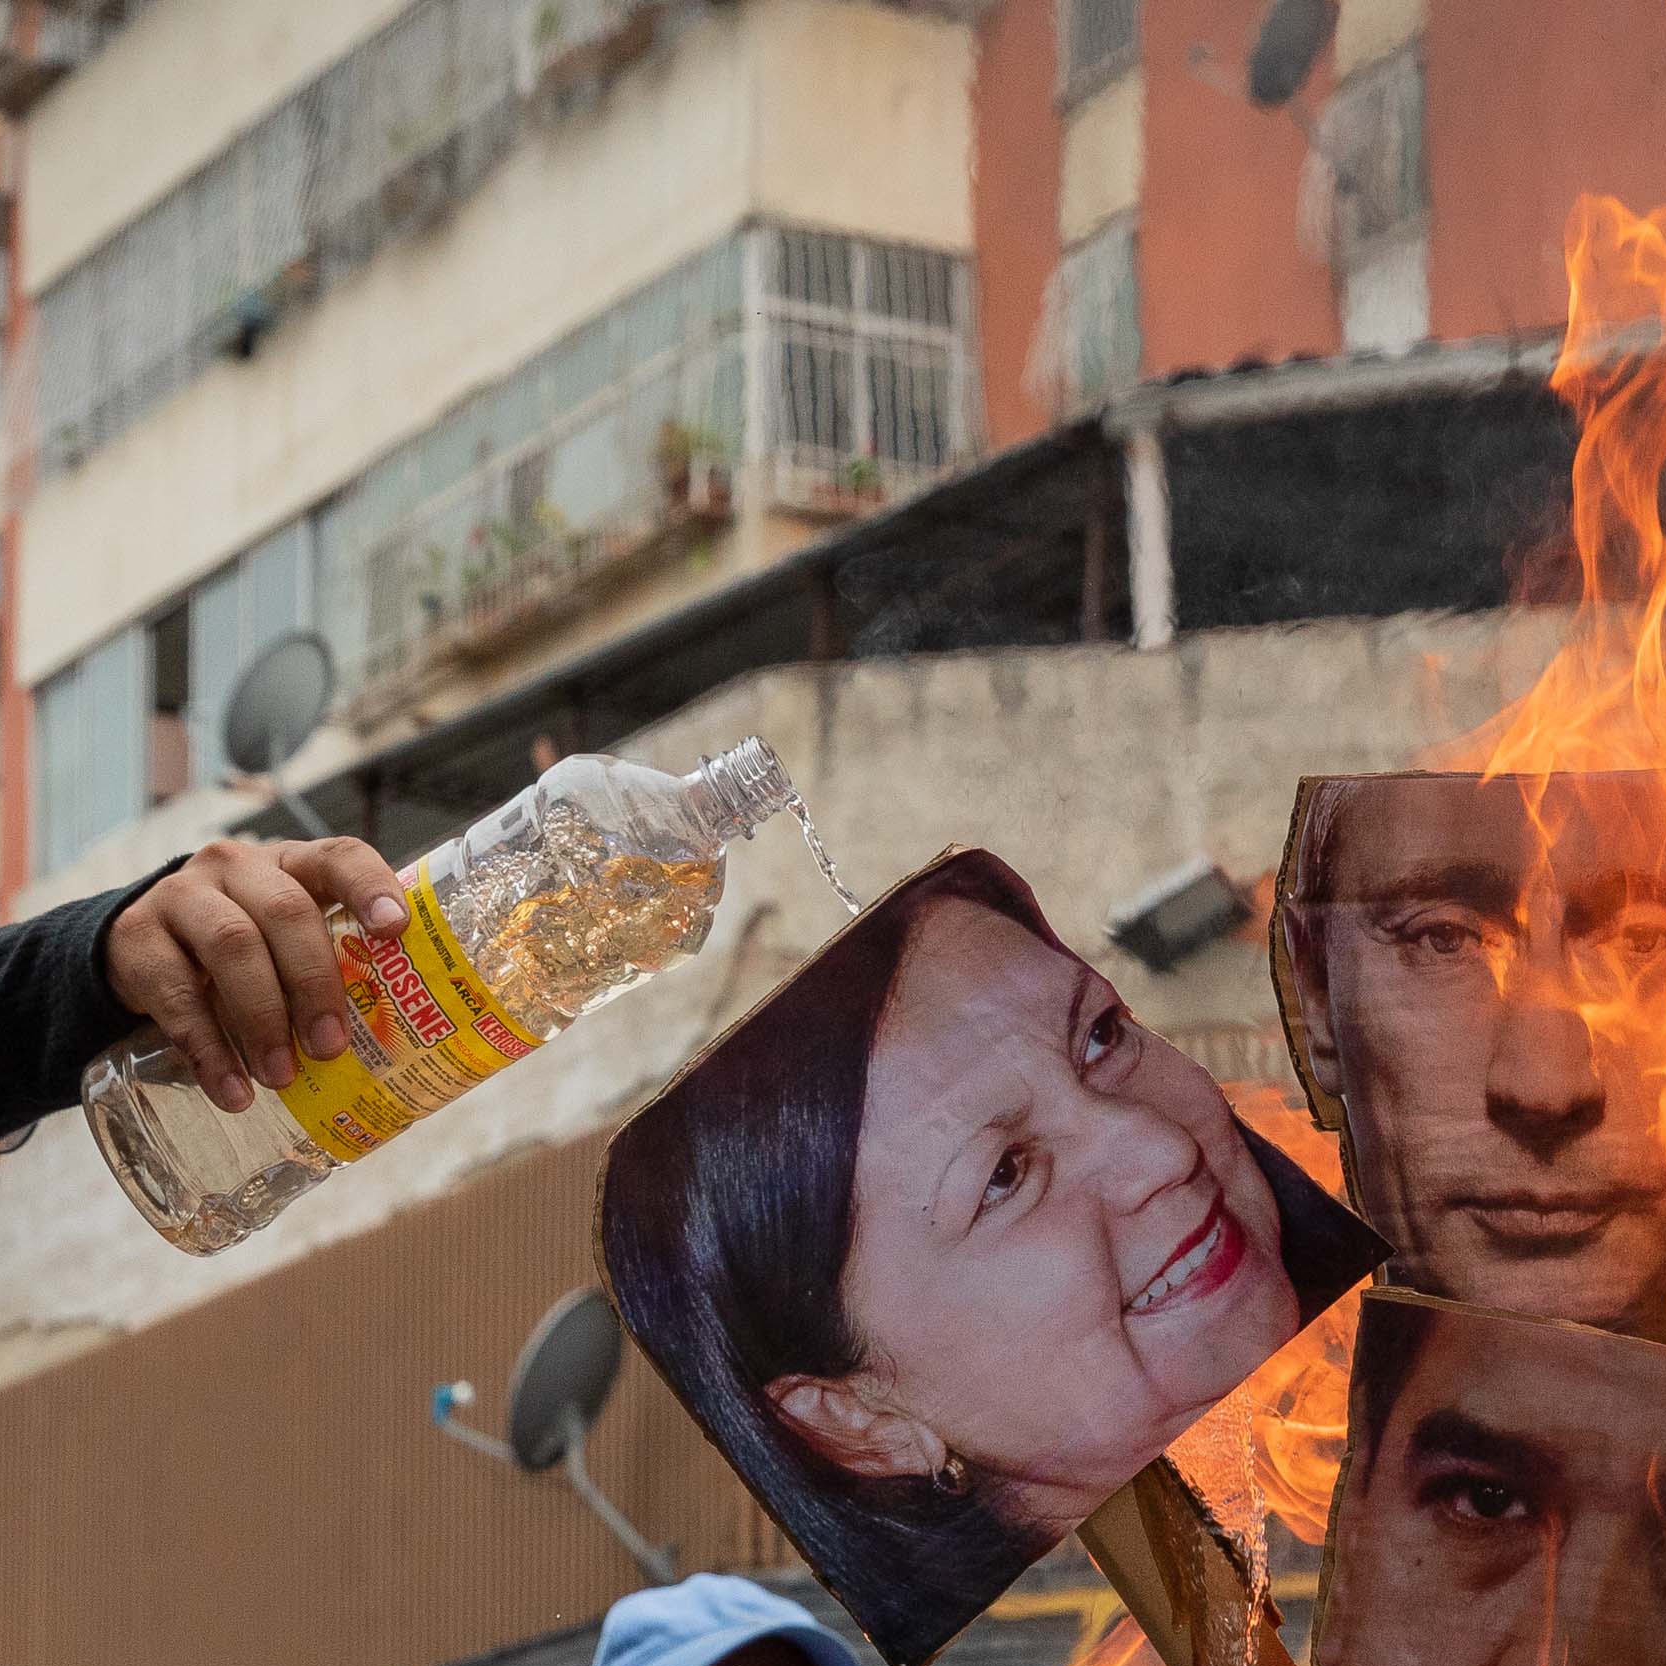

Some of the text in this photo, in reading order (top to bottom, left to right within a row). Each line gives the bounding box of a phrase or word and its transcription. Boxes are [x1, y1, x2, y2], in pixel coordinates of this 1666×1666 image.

[431, 933, 457, 972] INDUSTRIAL
[369, 937, 450, 1044] ROSENE
[451, 980, 484, 1016] ARCA
